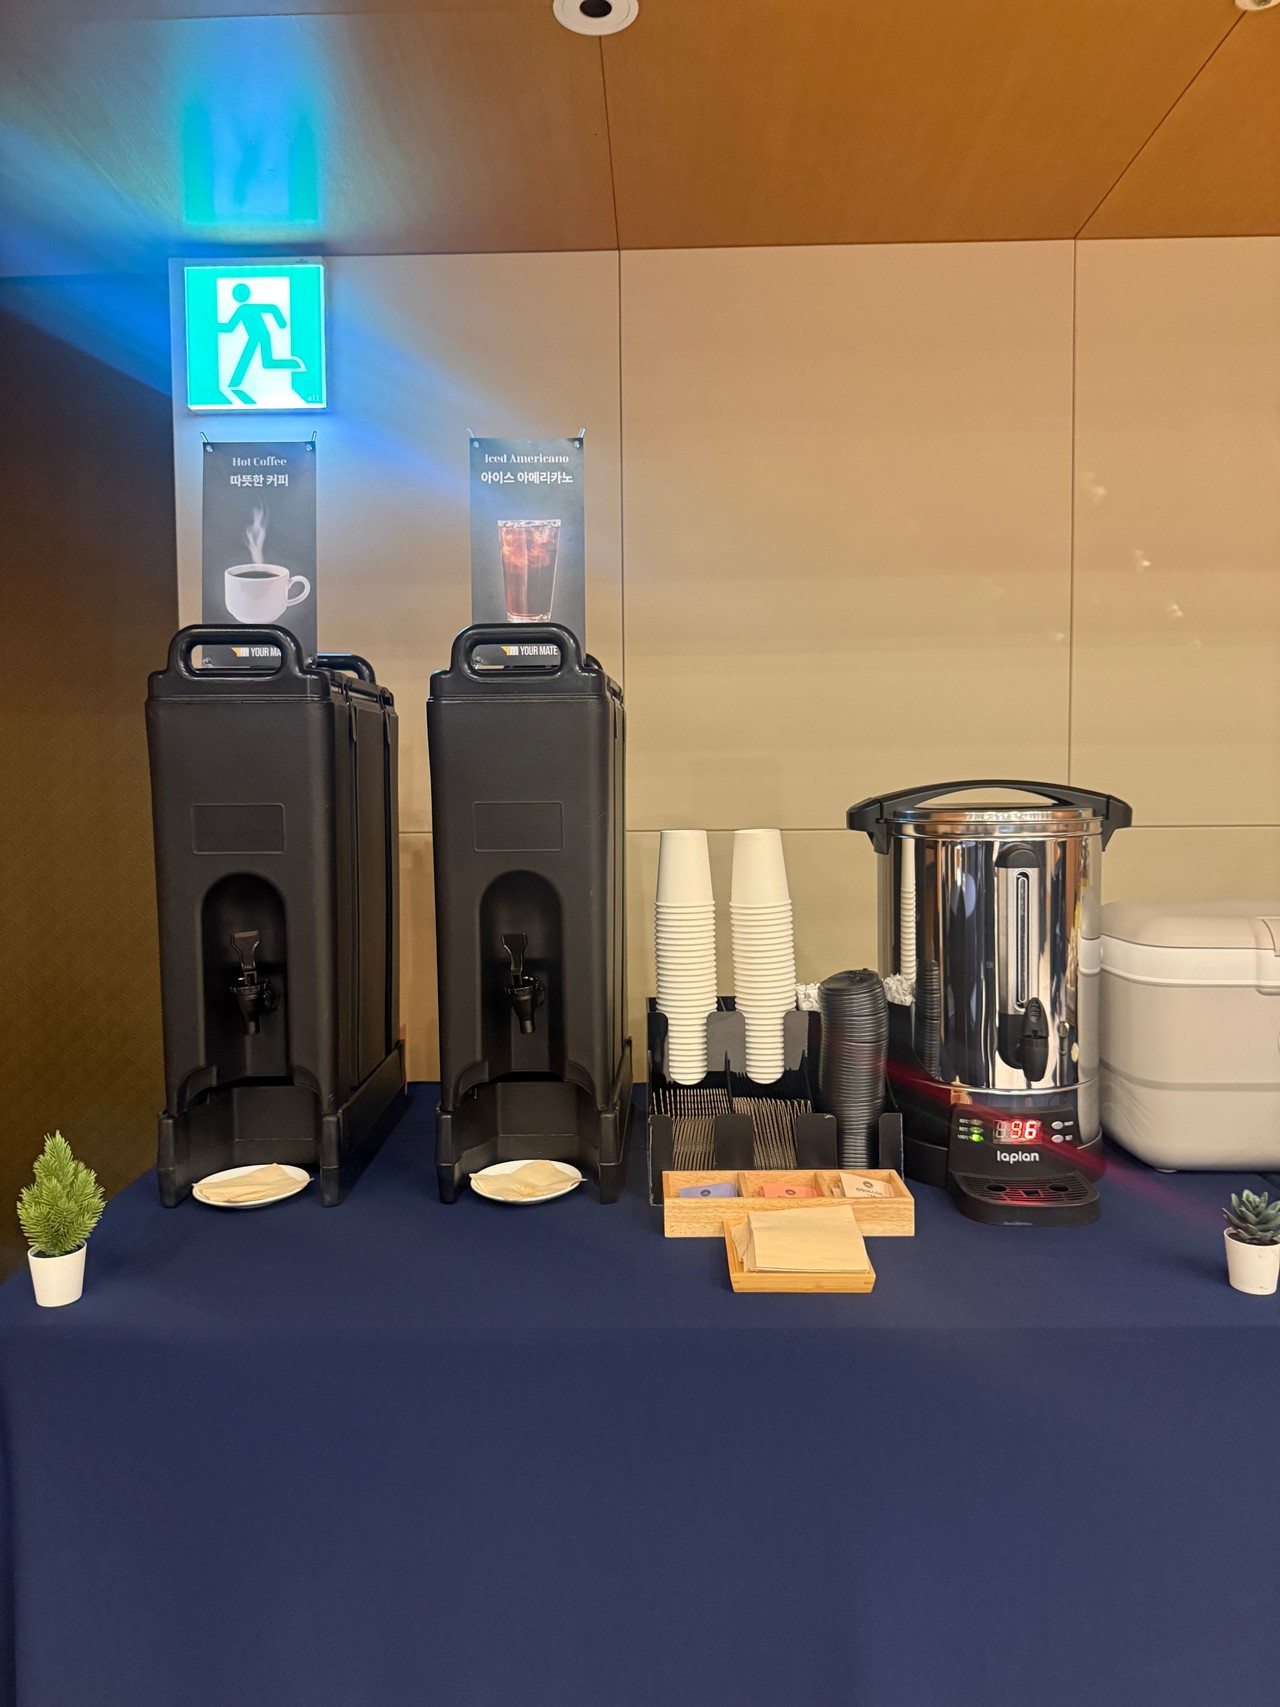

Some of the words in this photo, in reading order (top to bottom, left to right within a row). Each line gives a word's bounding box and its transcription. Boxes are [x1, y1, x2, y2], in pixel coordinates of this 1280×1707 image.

[232, 457, 251, 467] Hot
[253, 456, 287, 467] Coffee
[484, 453, 507, 464] Iced
[509, 453, 570, 464] Americano
[229, 474, 264, 487] 따뜻한
[266, 474, 289, 487] 커피
[480, 471, 515, 484] 아이스
[517, 471, 574, 484] 아메리카노
[250, 647, 269, 657] YOUR
[270, 647, 281, 657] MA
[520, 645, 538, 656] YOUR
[539, 645, 559, 656] MATE
[1010, 1120, 1037, 1140] 96
[996, 1150, 1040, 1164] laplan
